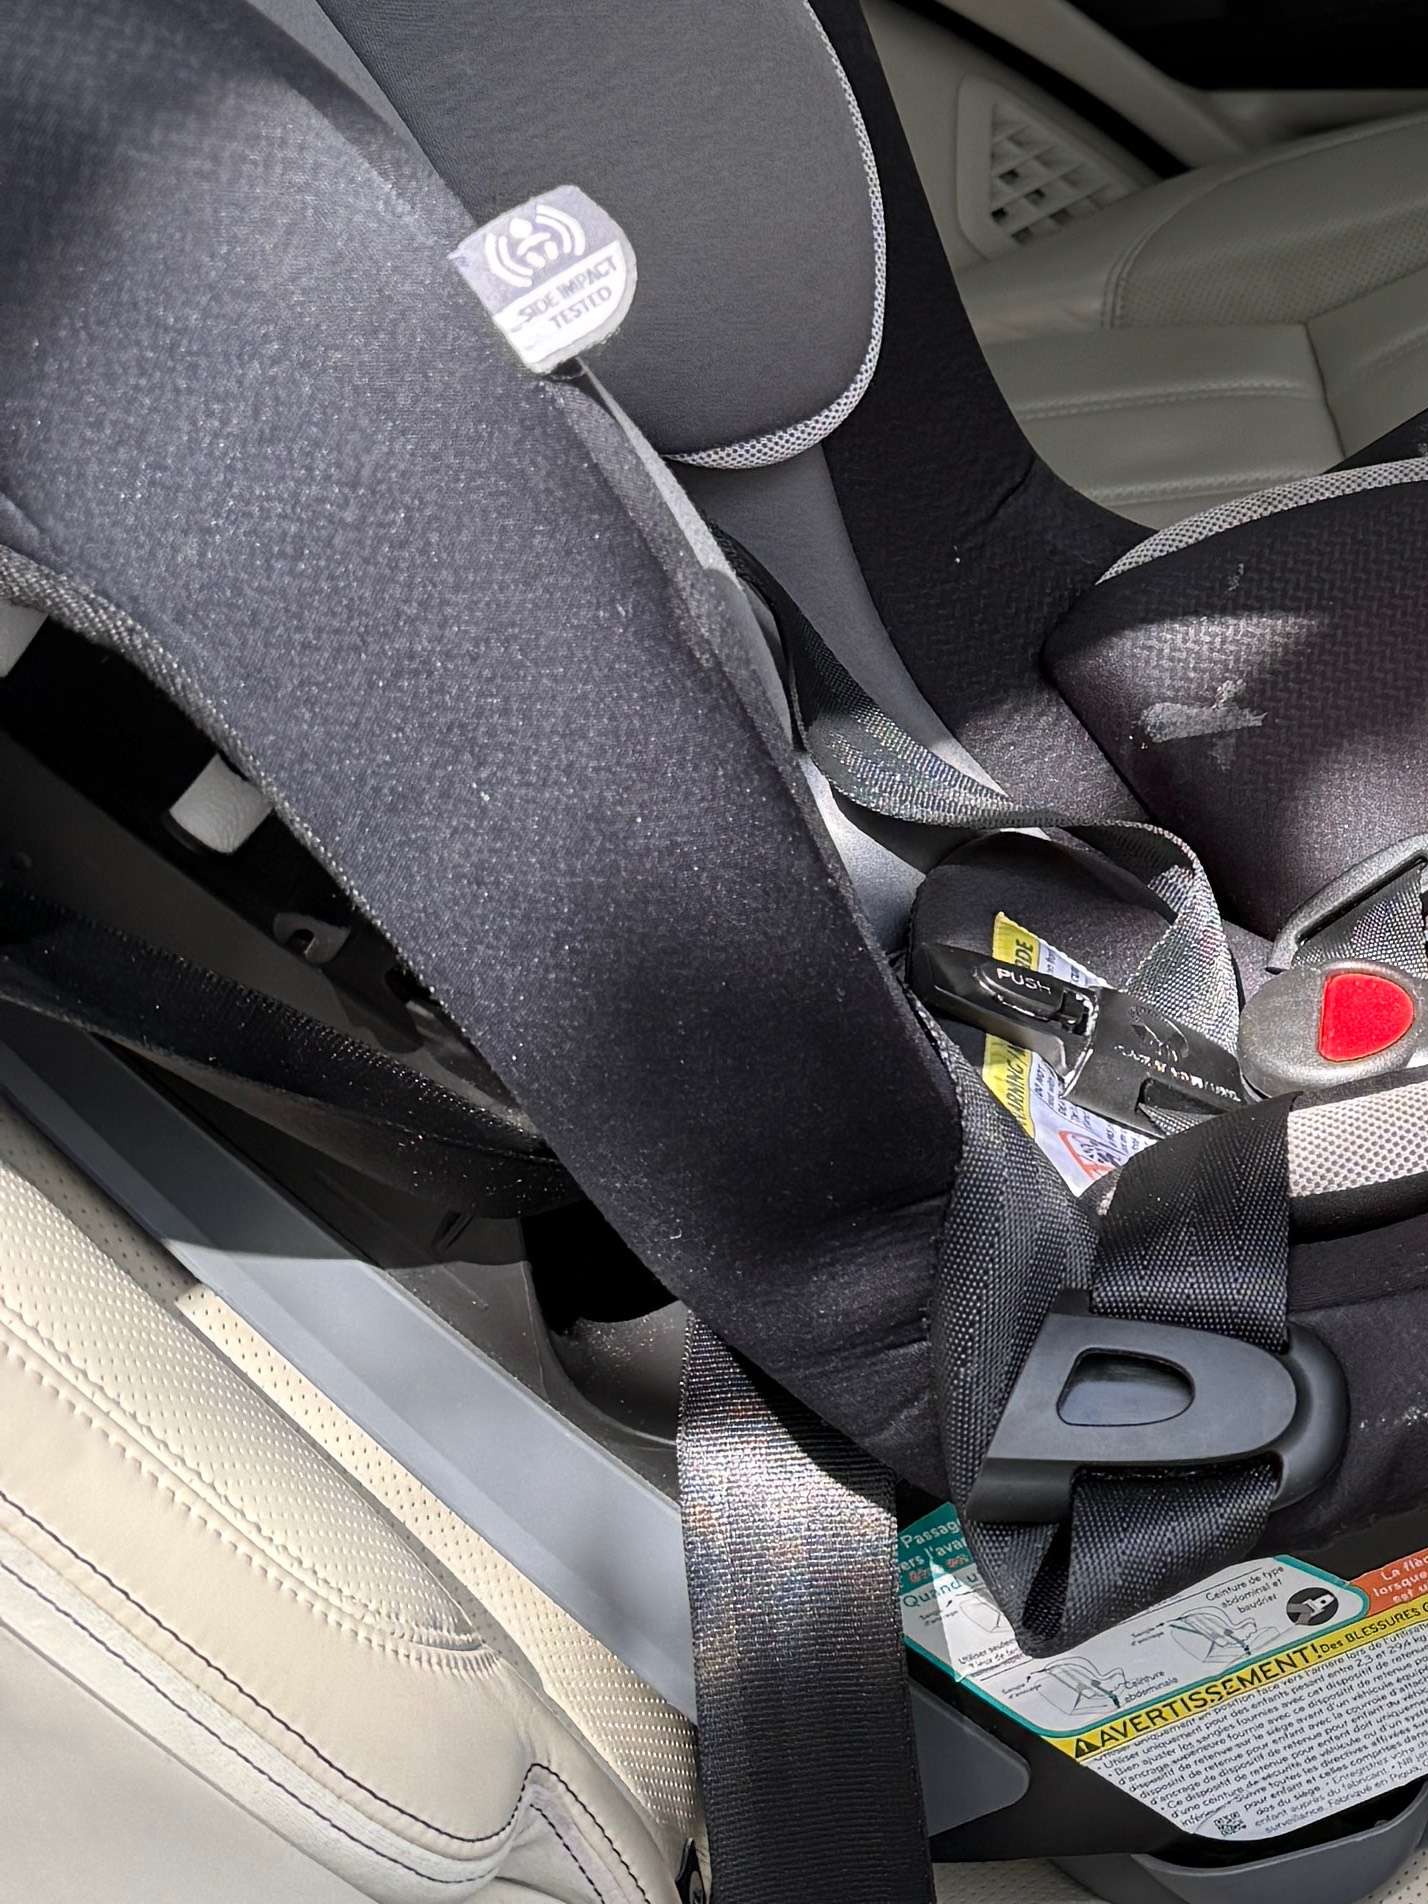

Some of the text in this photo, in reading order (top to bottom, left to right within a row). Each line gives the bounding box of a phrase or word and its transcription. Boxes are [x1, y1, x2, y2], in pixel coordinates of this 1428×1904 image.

[517, 256, 618, 324] SIDE IMPACT
[549, 286, 613, 329] TESTED
[996, 968, 1052, 995] PUSH
[1205, 1582, 1246, 1600] Ceinture
[1262, 1566, 1283, 1578] type
[1373, 1571, 1426, 1596] lorsque
[1380, 1569, 1399, 1580] La
[903, 1578, 962, 1608] Quand
[1221, 1578, 1281, 1607] abdominal et
[1392, 1588, 1412, 1602] est
[1319, 1640, 1343, 1653] Des
[1344, 1607, 1420, 1642] BLESSURES
